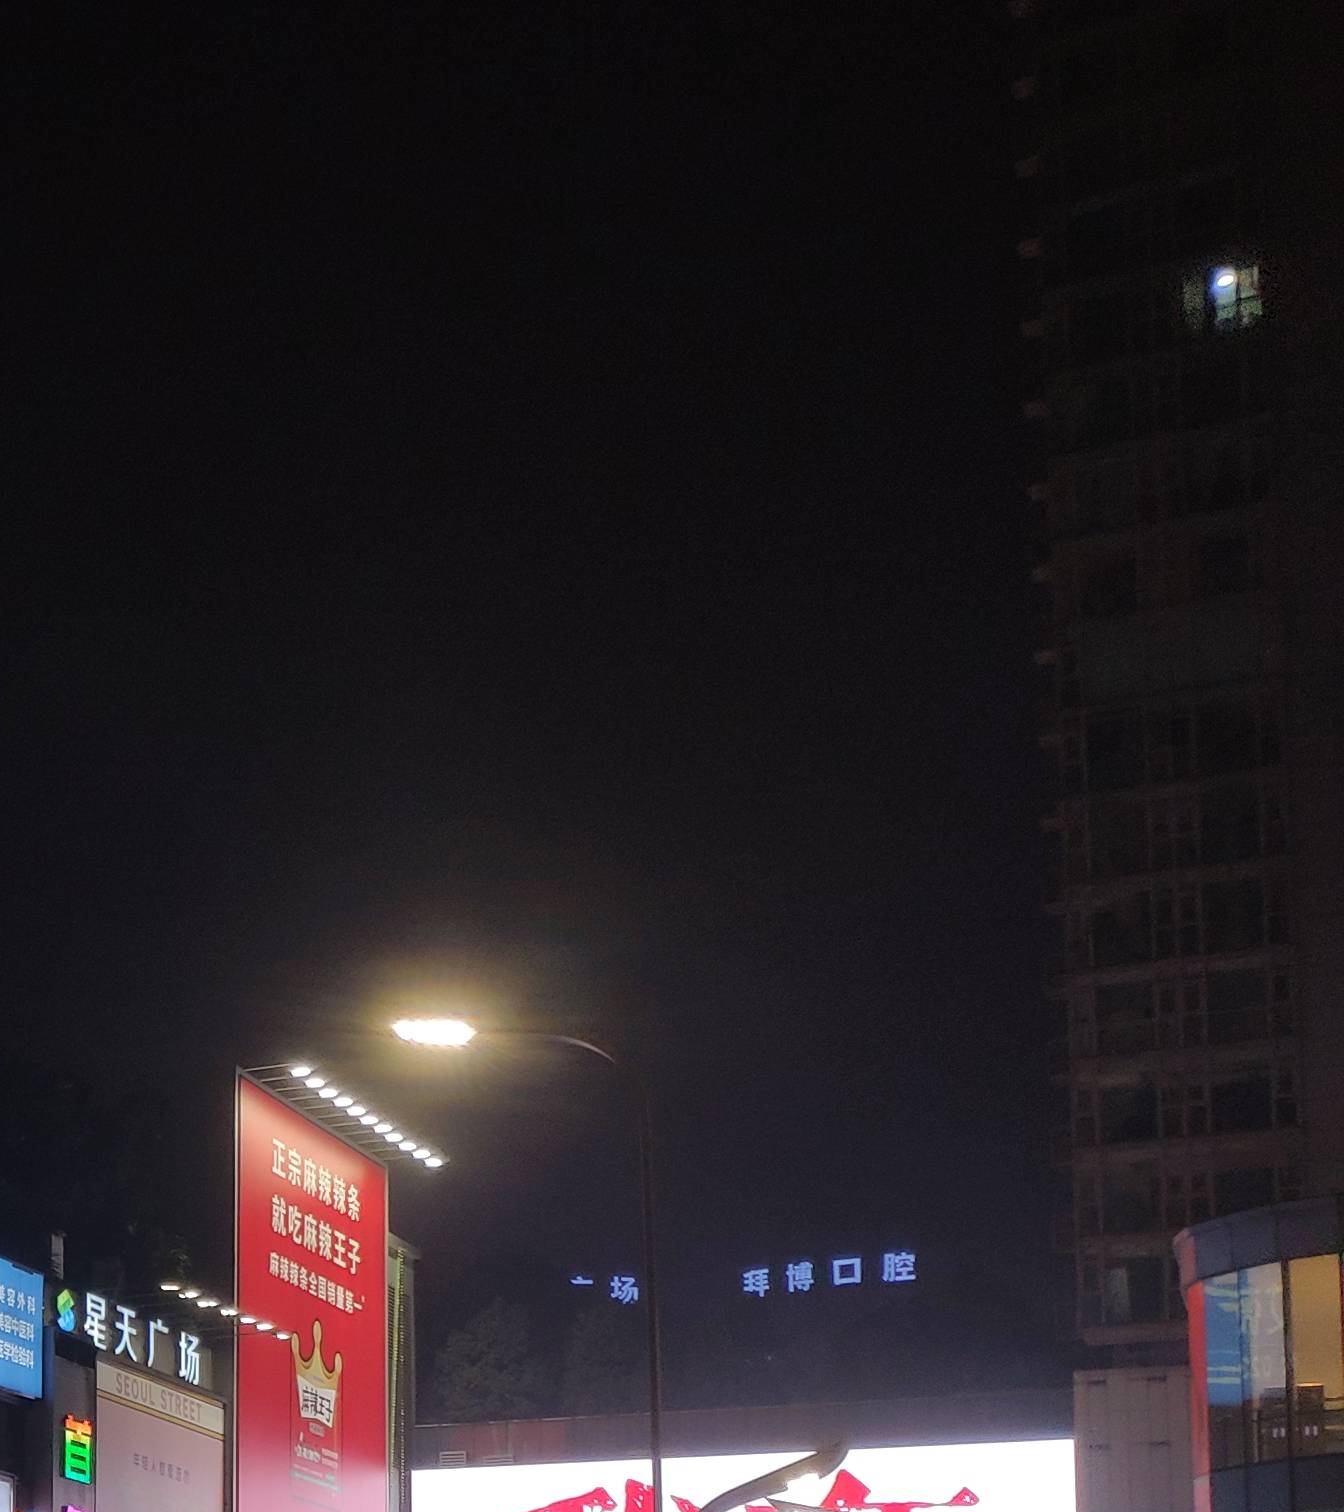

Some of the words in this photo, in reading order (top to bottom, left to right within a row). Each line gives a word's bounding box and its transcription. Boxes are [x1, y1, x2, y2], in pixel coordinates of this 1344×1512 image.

[271, 1137, 362, 1223] 正宗麻辣辣条
[270, 1194, 362, 1277] 就吃麻辣王子
[742, 1251, 917, 1299] 拜博口腔
[83, 1292, 200, 1385] 星天广场
[115, 1372, 155, 1407] SEOUL
[161, 1392, 202, 1423] STREET
